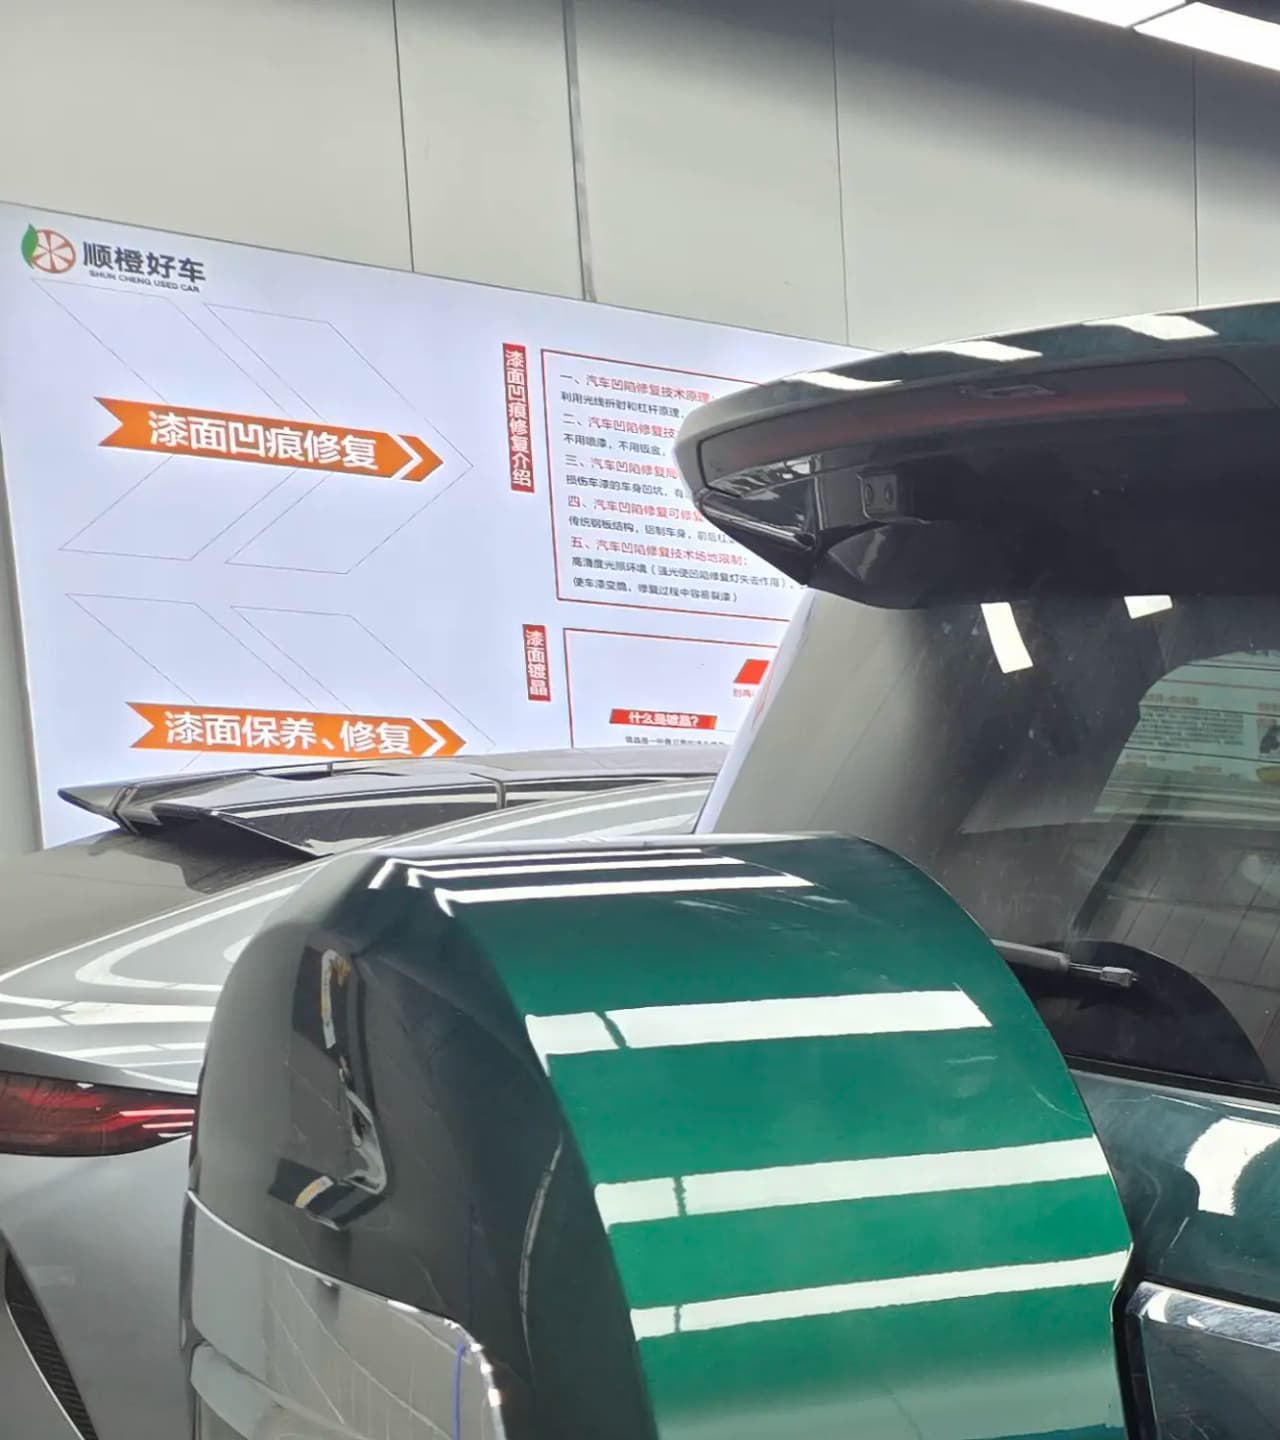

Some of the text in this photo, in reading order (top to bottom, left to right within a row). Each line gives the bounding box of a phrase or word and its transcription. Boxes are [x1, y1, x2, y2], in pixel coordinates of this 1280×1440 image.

[82, 241, 206, 283] 顺橙好车
[89, 270, 200, 293] SHUN CHENG USED CAR
[147, 410, 379, 470] 漆面凹痕修复
[505, 349, 532, 488] 漆面凹痕修复介绍
[164, 711, 413, 755] 漆面保养、修复
